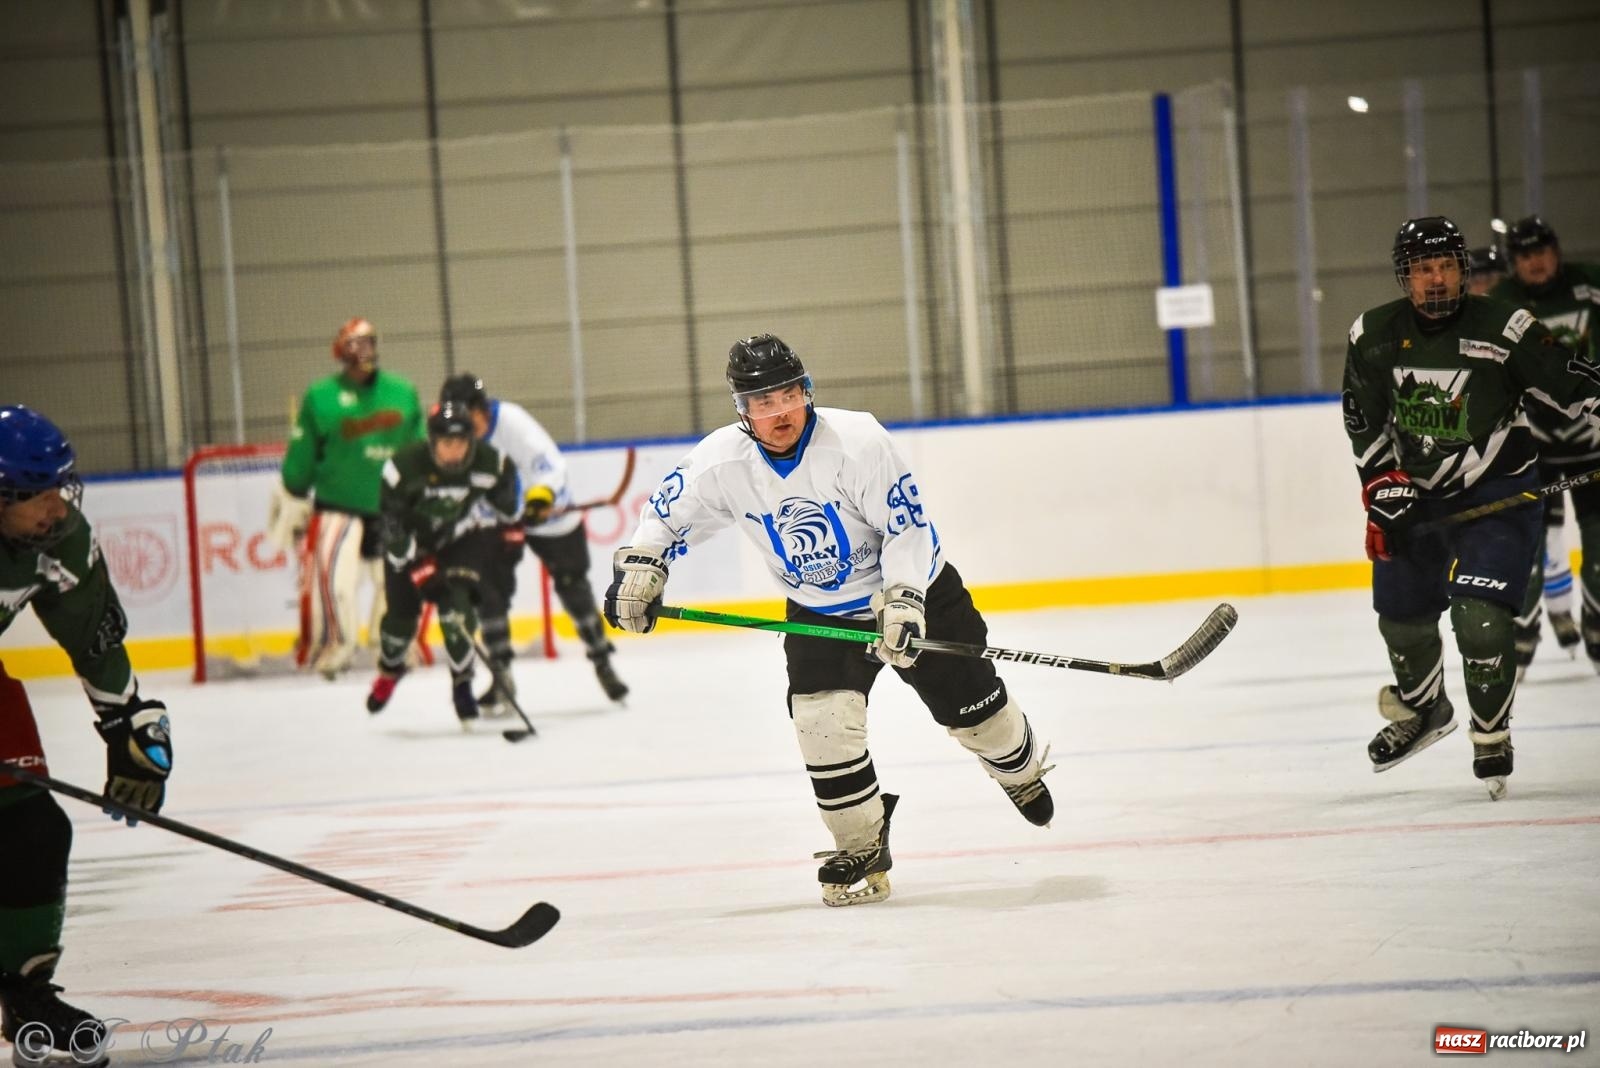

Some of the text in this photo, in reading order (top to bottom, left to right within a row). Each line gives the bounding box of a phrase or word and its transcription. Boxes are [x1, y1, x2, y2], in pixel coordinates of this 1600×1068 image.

[1374, 486, 1418, 500] BAU
[1540, 475, 1590, 495] TACKS
[624, 554, 669, 577] BAU
[1456, 574, 1508, 591] CCM
[980, 647, 1073, 670] BAUER
[959, 686, 1001, 715] EASTON
